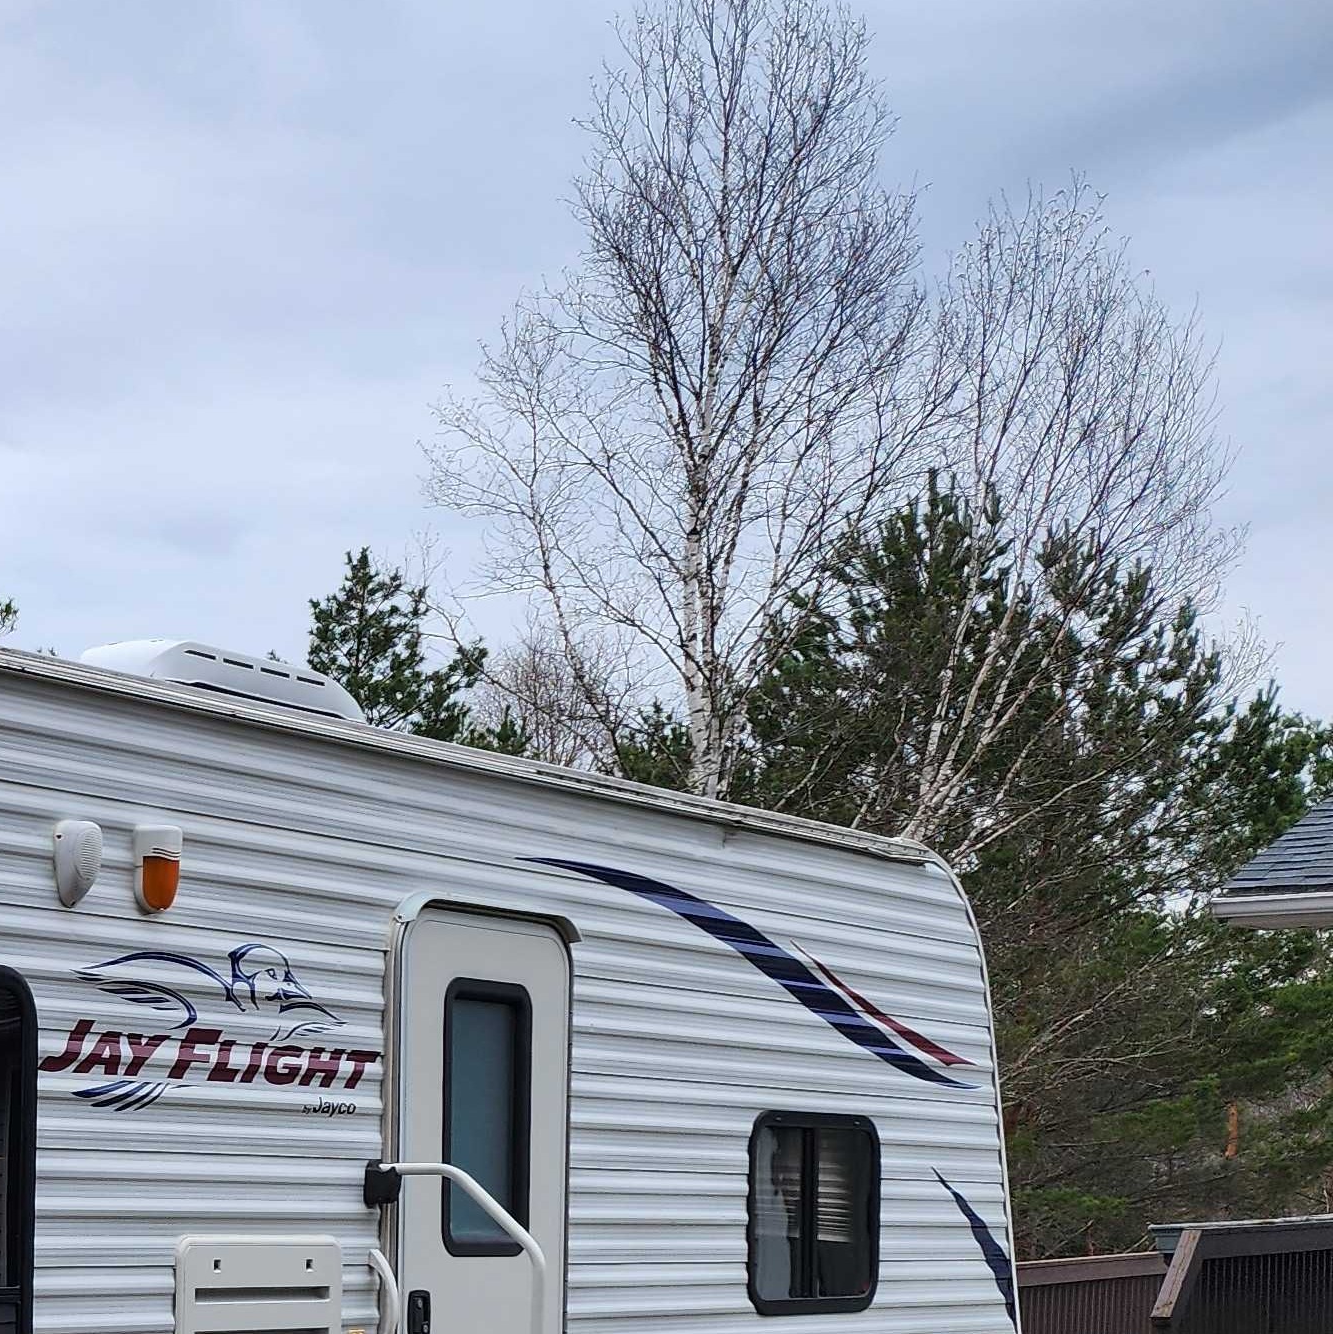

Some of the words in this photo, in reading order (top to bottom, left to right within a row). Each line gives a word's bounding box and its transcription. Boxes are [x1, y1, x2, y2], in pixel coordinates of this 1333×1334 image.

[37, 1019, 171, 1077] JAY
[167, 1028, 382, 1090] FLIGHT
[312, 1096, 357, 1117] Jayco
